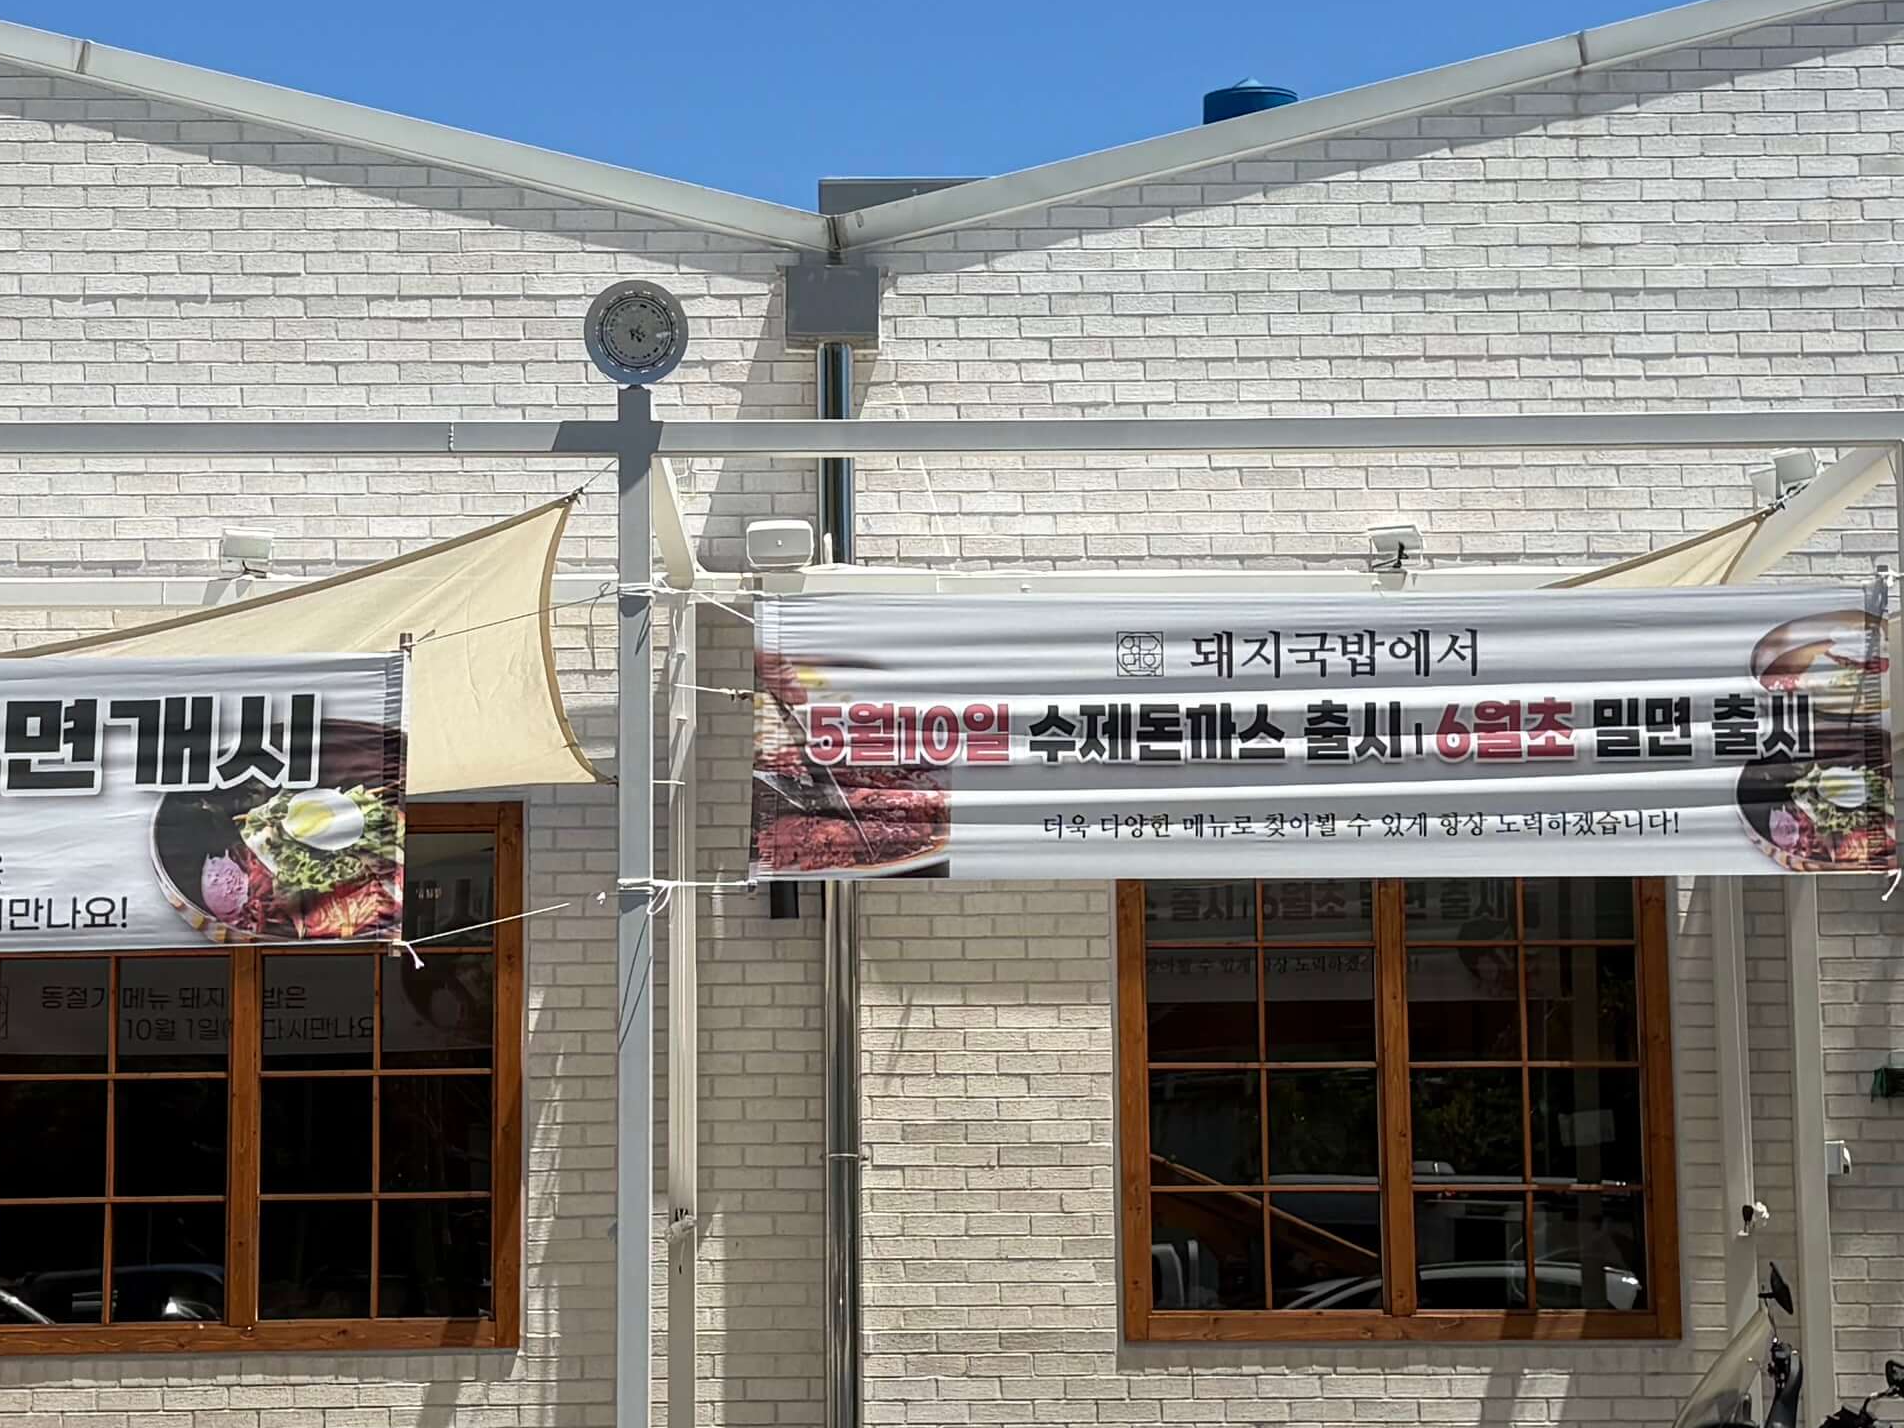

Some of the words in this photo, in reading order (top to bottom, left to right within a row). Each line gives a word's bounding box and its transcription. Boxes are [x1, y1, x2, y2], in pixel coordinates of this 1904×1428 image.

[1190, 628, 1479, 679] 돼지국밥에서
[1028, 702, 1287, 763] 수제돈까스
[1595, 695, 1693, 758] 밀면
[1711, 691, 1815, 758] 출시
[1043, 815, 1091, 840] 더욱
[1099, 814, 1171, 839] 다양한
[1182, 814, 1256, 838] 메뉴로
[1346, 813, 1373, 838] 수
[1381, 812, 1428, 838] 있게
[1438, 811, 1487, 837] 항상
[1496, 809, 1680, 837] 노력하겠습니다!
